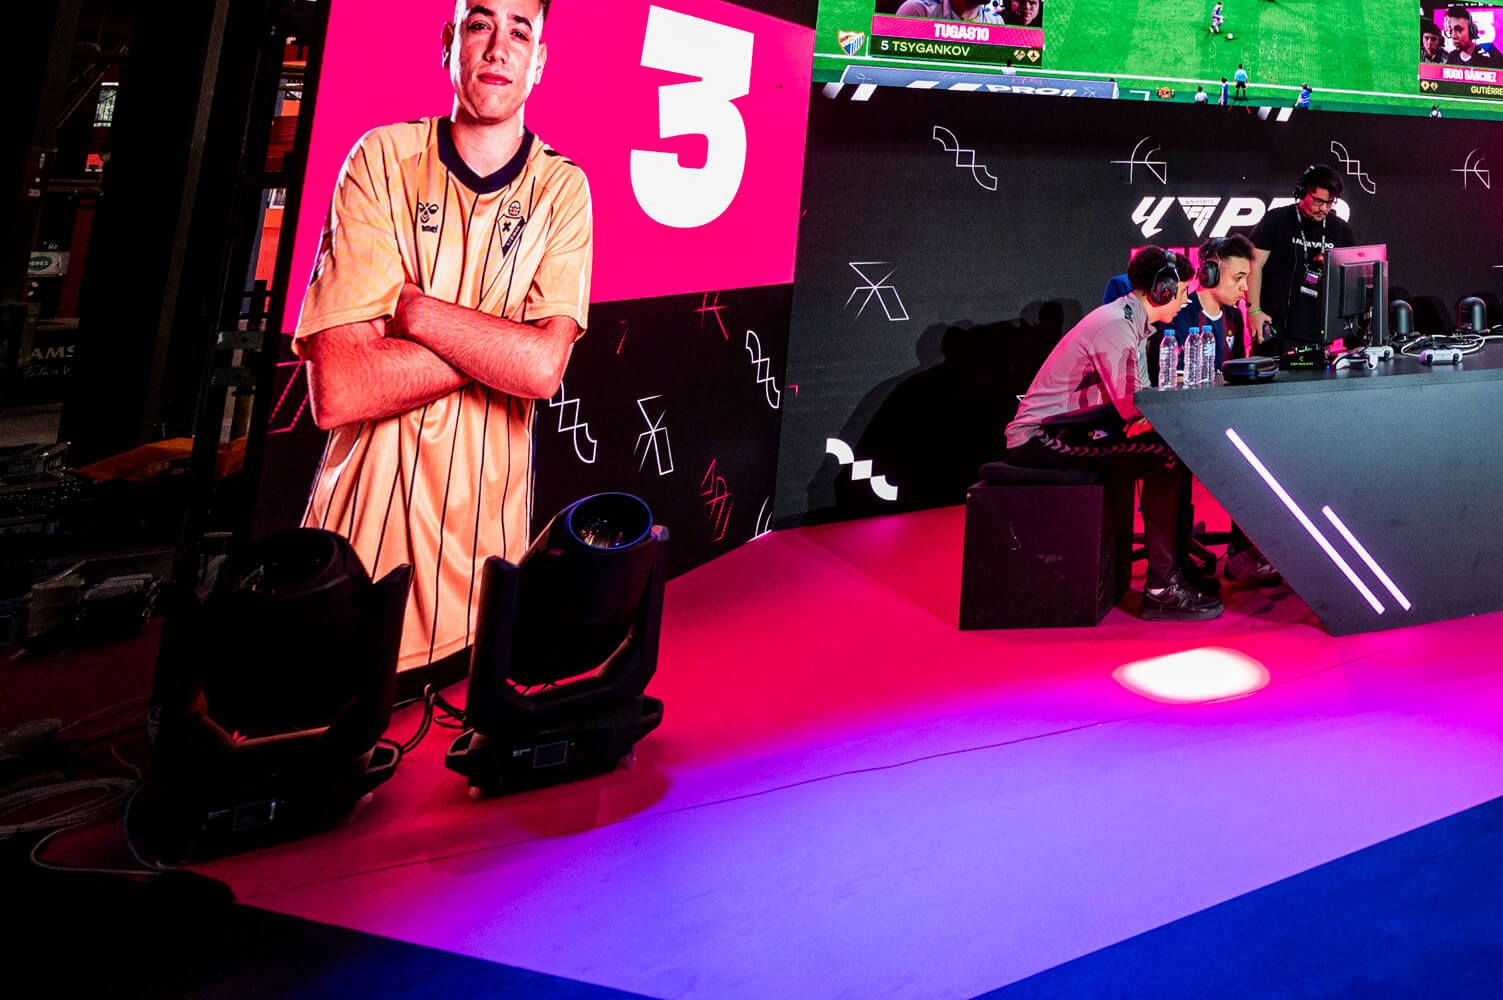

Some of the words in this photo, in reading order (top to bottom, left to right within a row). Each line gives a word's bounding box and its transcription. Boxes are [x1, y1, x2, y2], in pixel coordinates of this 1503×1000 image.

[933, 23, 990, 41] TUGA810
[880, 40, 889, 51] 5
[892, 40, 970, 57] TSYGANKOV
[630, 4, 755, 229] 3
